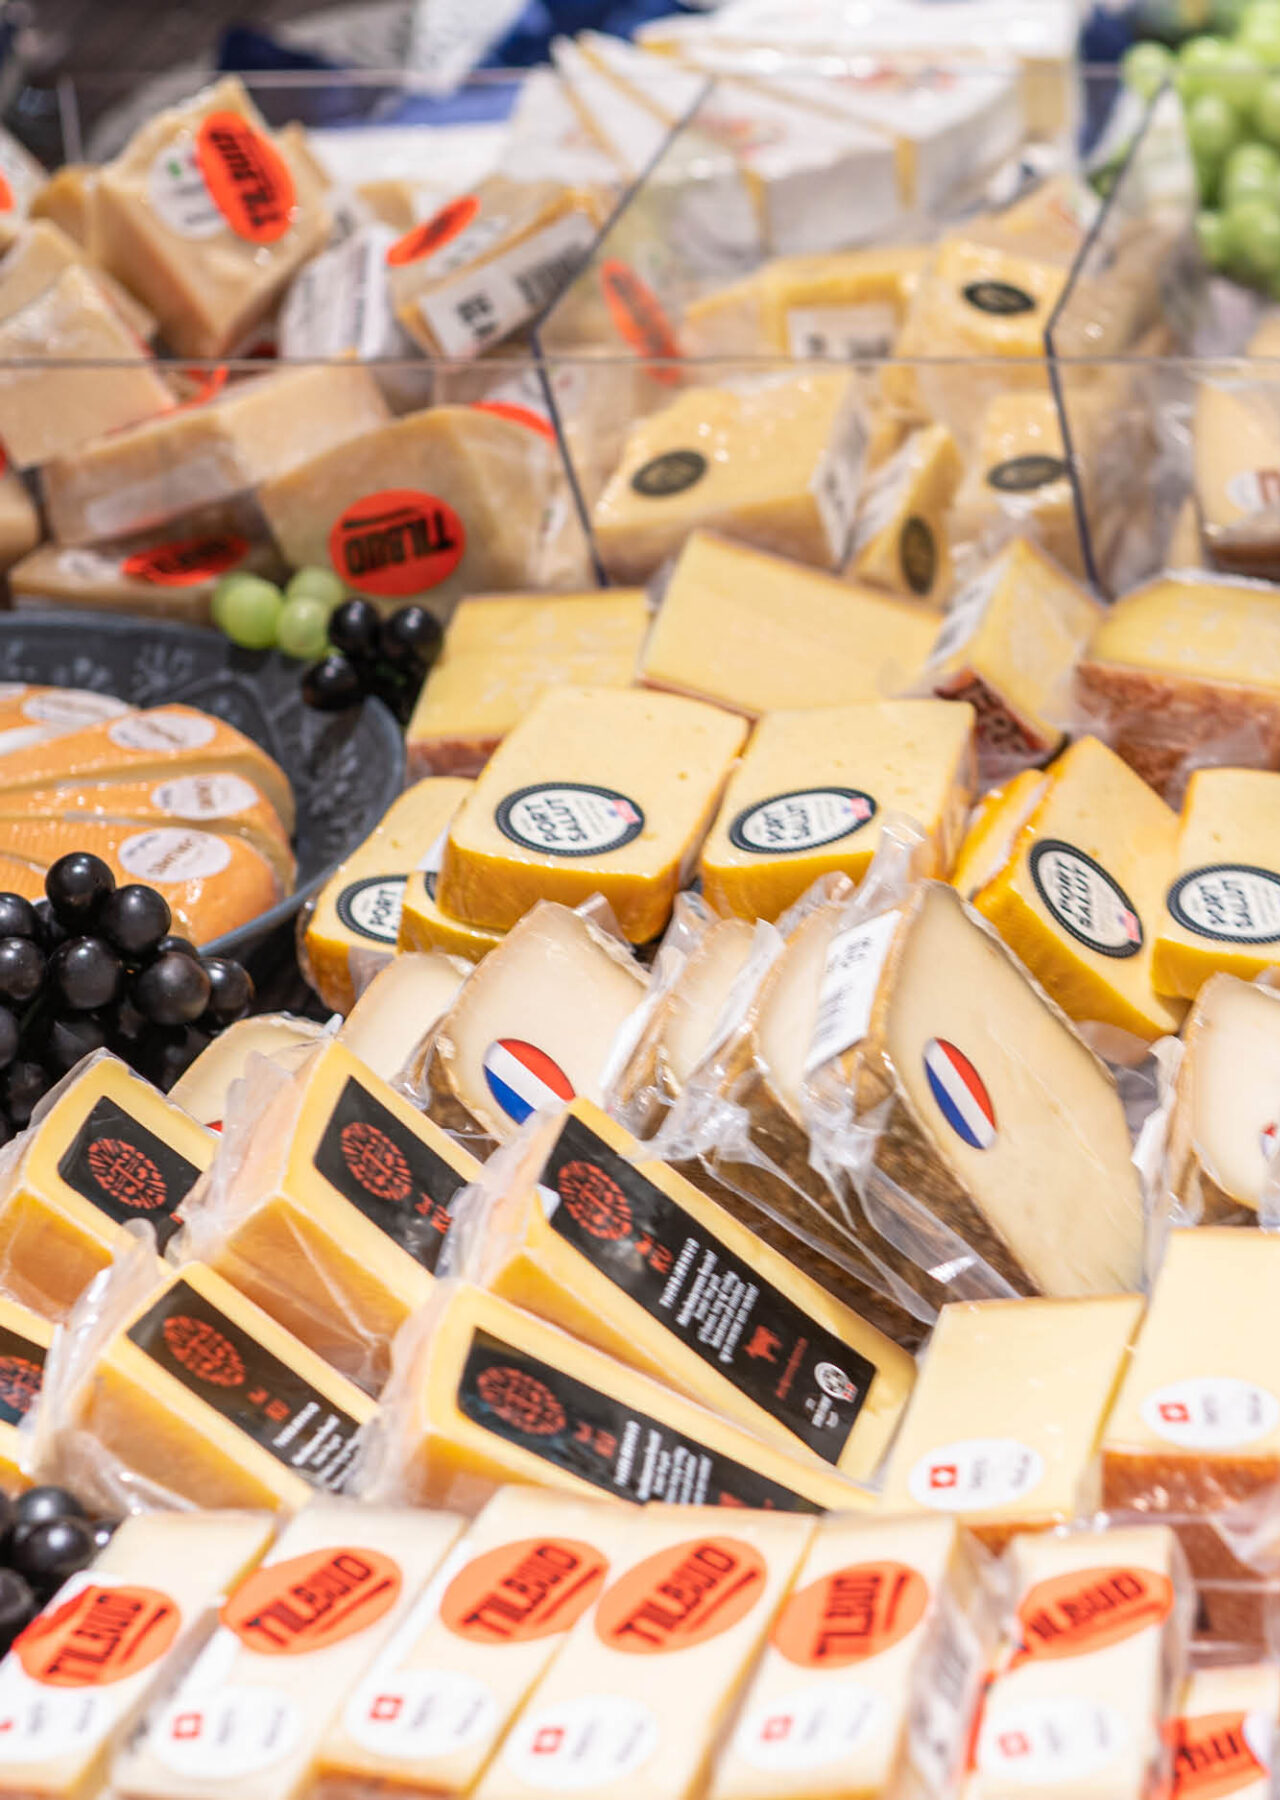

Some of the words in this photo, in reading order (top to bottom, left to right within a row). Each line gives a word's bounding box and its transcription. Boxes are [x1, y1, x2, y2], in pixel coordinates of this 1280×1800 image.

[210, 131, 282, 229] TILBUD
[344, 509, 456, 576] TILBUD
[524, 803, 560, 843] PORT
[545, 798, 589, 842] SALUT
[761, 811, 786, 842] PORT
[784, 802, 812, 840] SALUT
[369, 890, 398, 928] PORT
[1056, 858, 1073, 914] PORT
[1073, 865, 1096, 931] SALUT
[1199, 881, 1227, 926] PORT
[1221, 879, 1256, 929] SALUT
[246, 1553, 374, 1647] TILBUD
[459, 1543, 583, 1638] TILBUD
[613, 1541, 738, 1646] TILBUD
[809, 1572, 882, 1662] TILBUD
[1026, 1570, 1146, 1645] ILBUD
[43, 1593, 143, 1681] TILBUD
